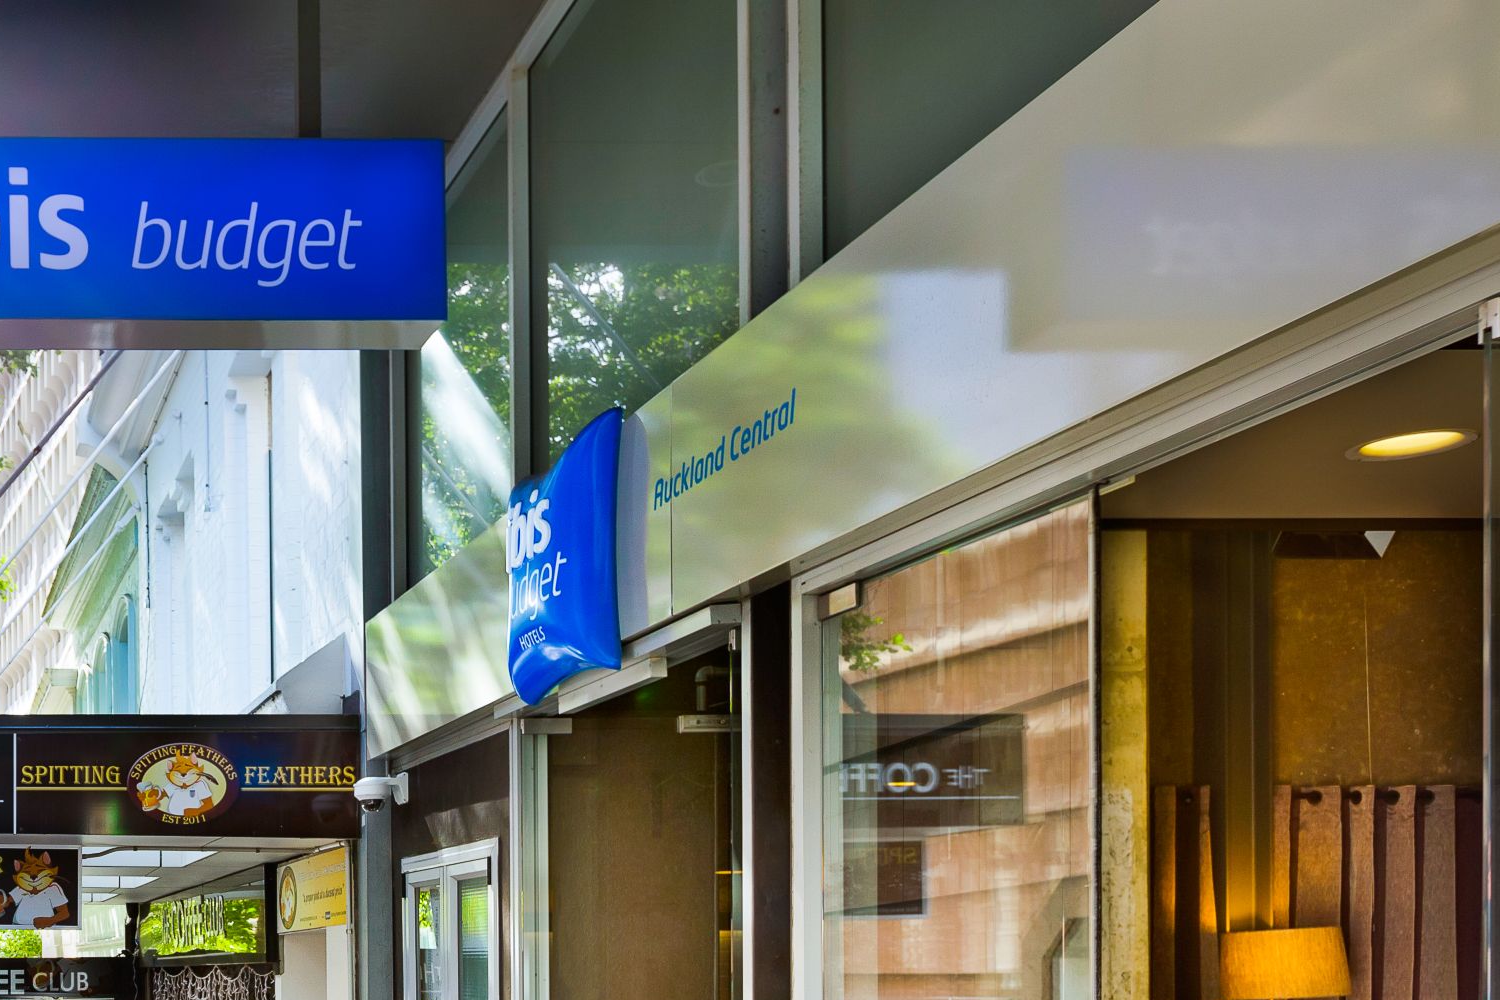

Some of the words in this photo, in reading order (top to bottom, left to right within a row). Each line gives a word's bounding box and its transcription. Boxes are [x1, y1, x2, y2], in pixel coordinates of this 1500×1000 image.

[131, 200, 363, 288] budget
[653, 435, 726, 511] Auckland
[729, 387, 797, 462] Central
[510, 551, 568, 621] udget
[519, 625, 546, 650] HOTELS
[20, 765, 121, 786] SPITTING
[243, 765, 356, 787] FEATHERS
[130, 745, 177, 780] SPITTING
[181, 744, 238, 781] FEATHERS
[161, 814, 181, 825] EST
[182, 813, 206, 824] 2011
[32, 971, 90, 993] CLUB
